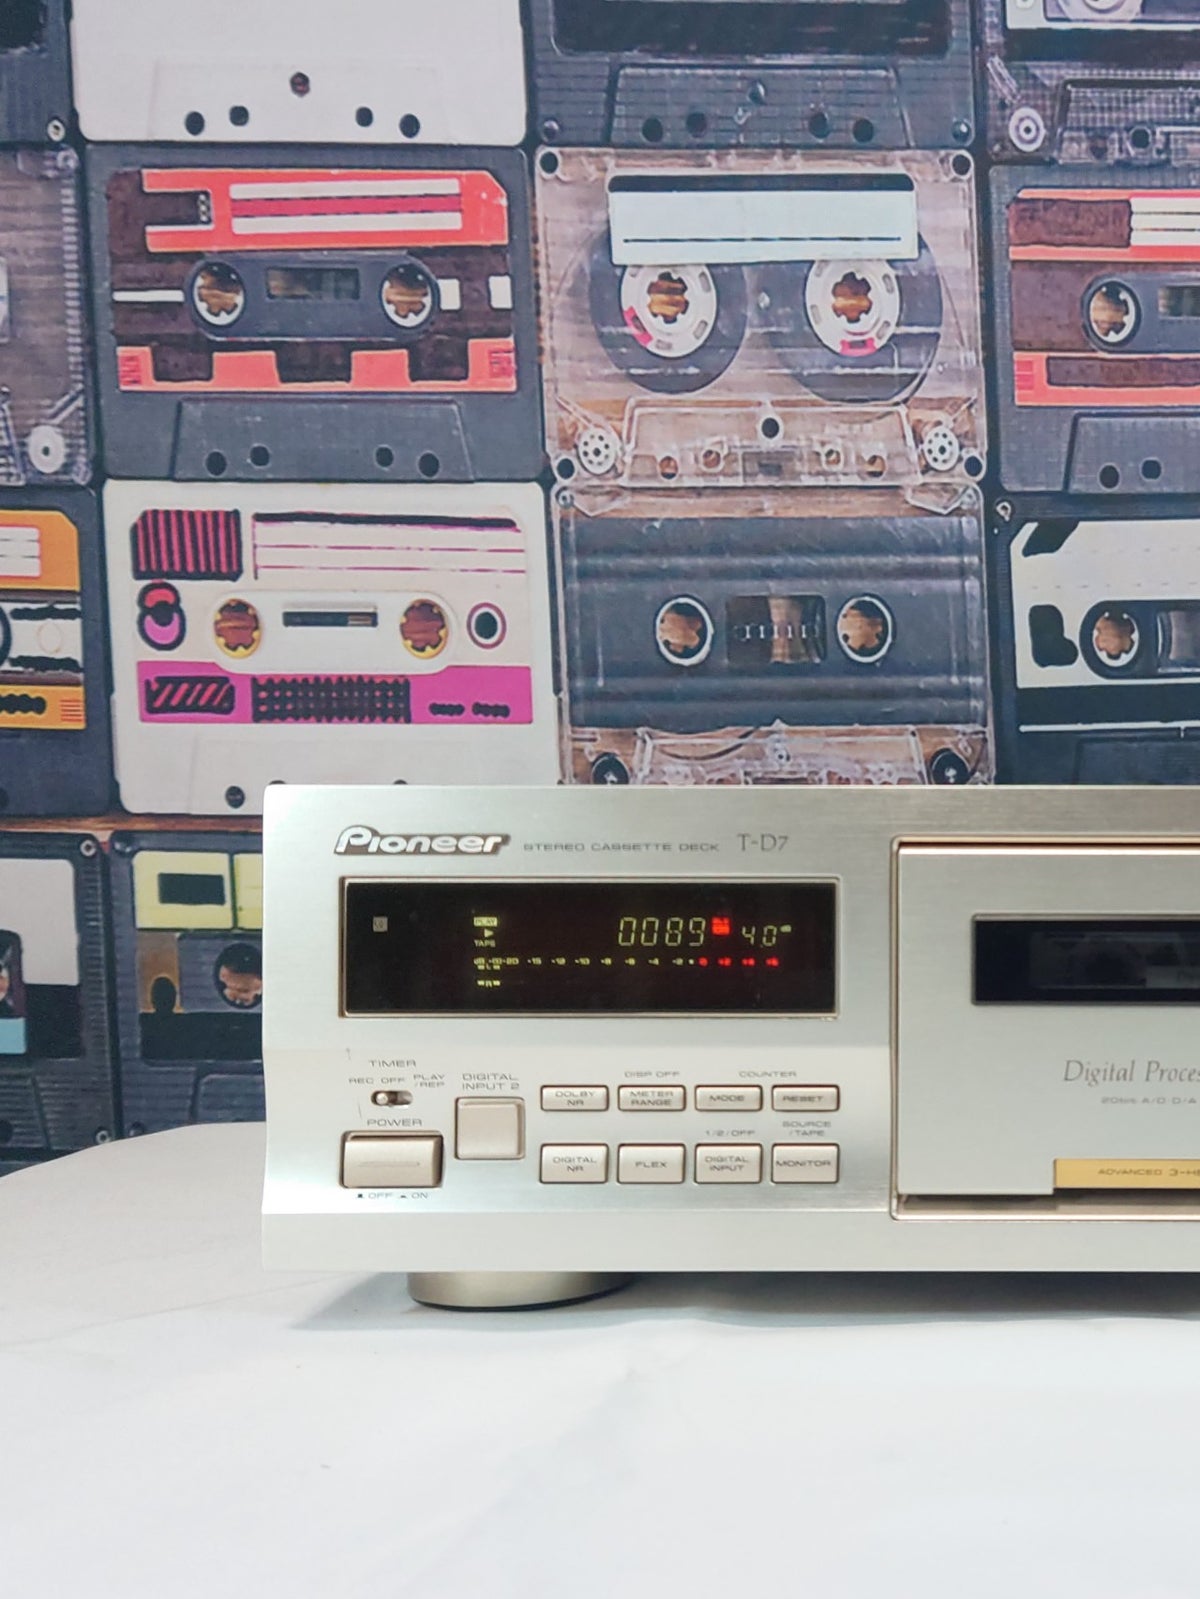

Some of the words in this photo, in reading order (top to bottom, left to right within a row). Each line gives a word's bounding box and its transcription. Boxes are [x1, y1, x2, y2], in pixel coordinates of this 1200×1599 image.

[334, 825, 511, 855] Pioneer
[737, 833, 789, 852] T-D7
[523, 843, 585, 851] STEREO
[591, 843, 673, 851] CASSETTE
[679, 843, 720, 851] DECK
[618, 917, 706, 947] 0089
[369, 1059, 417, 1068] TIMER
[1063, 1059, 1136, 1087] Digital
[348, 1077, 375, 1085] REC
[380, 1077, 405, 1085] OFF
[462, 1073, 519, 1082] DIGITAL
[462, 1083, 503, 1091] INPUT
[510, 1083, 520, 1091] 2
[555, 1090, 595, 1098] DOLBY
[630, 1090, 674, 1098] METER
[709, 1094, 745, 1102] MODE
[631, 1099, 672, 1107] RANGE
[782, 1095, 824, 1103] RESET
[367, 1119, 422, 1127] POWER
[782, 1120, 831, 1128] SOURCE
[553, 1156, 597, 1164] DIGITAL
[705, 1155, 748, 1163] DIGITAL
